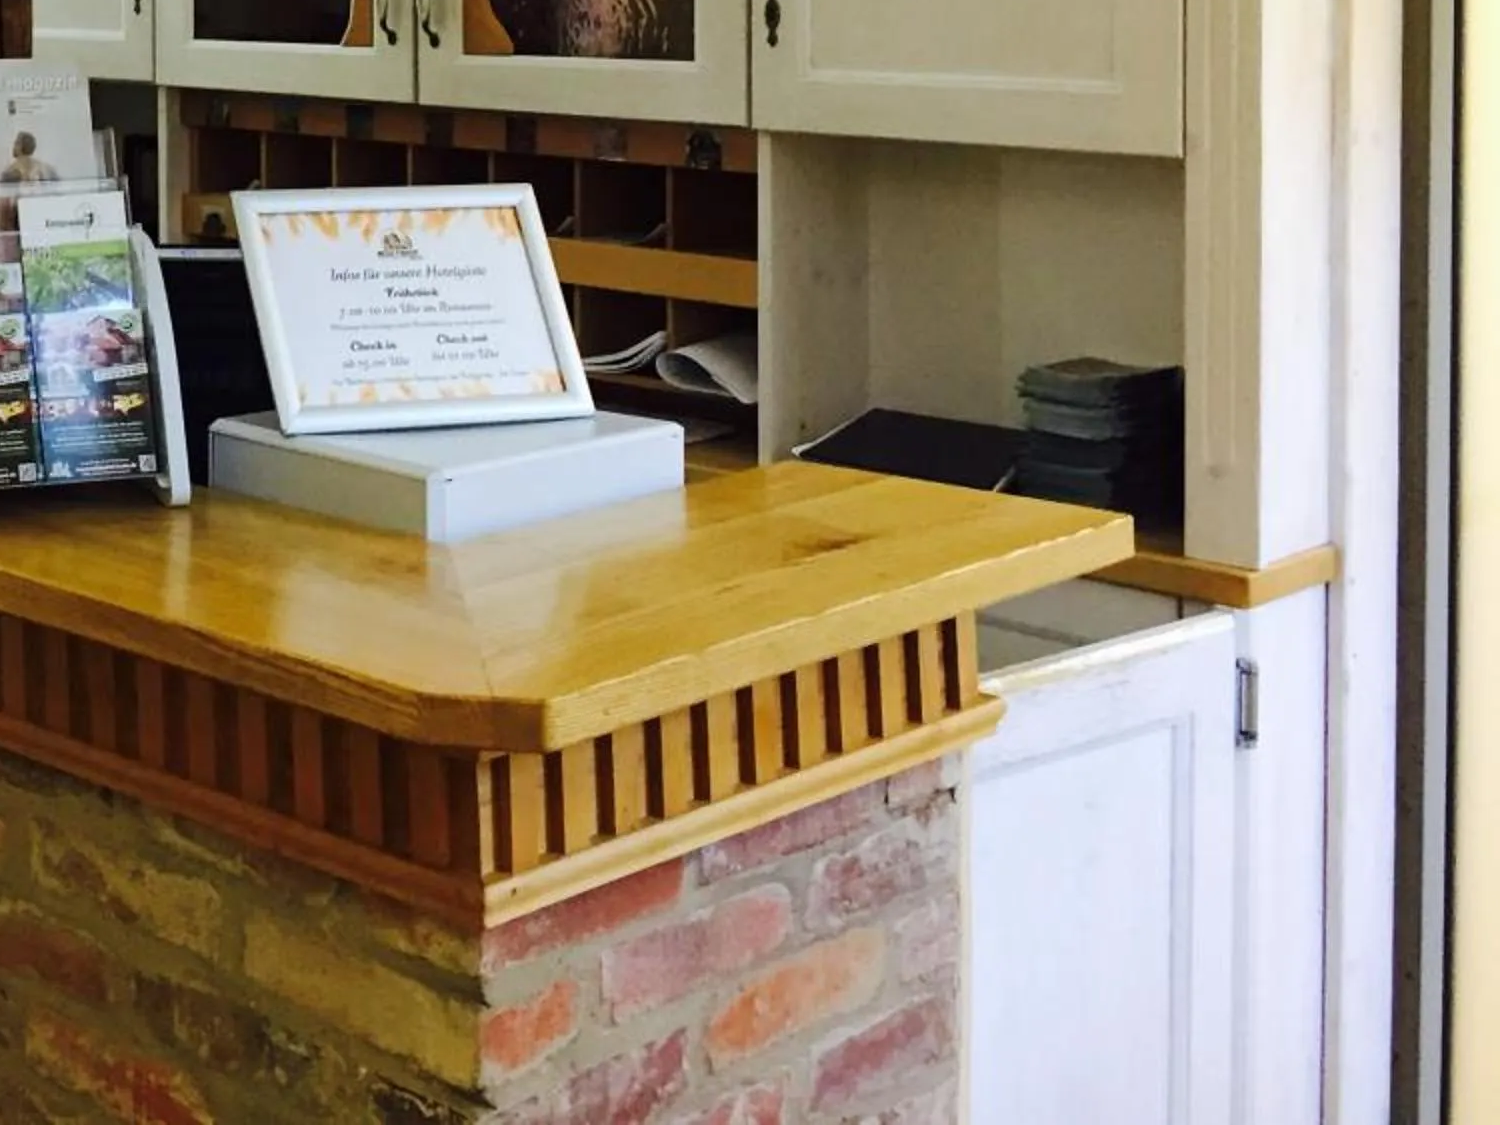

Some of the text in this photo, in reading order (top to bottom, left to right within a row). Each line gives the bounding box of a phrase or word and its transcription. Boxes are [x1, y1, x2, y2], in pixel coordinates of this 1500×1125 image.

[363, 267, 380, 283] für
[349, 339, 383, 352] Check
[436, 333, 469, 345] Check
